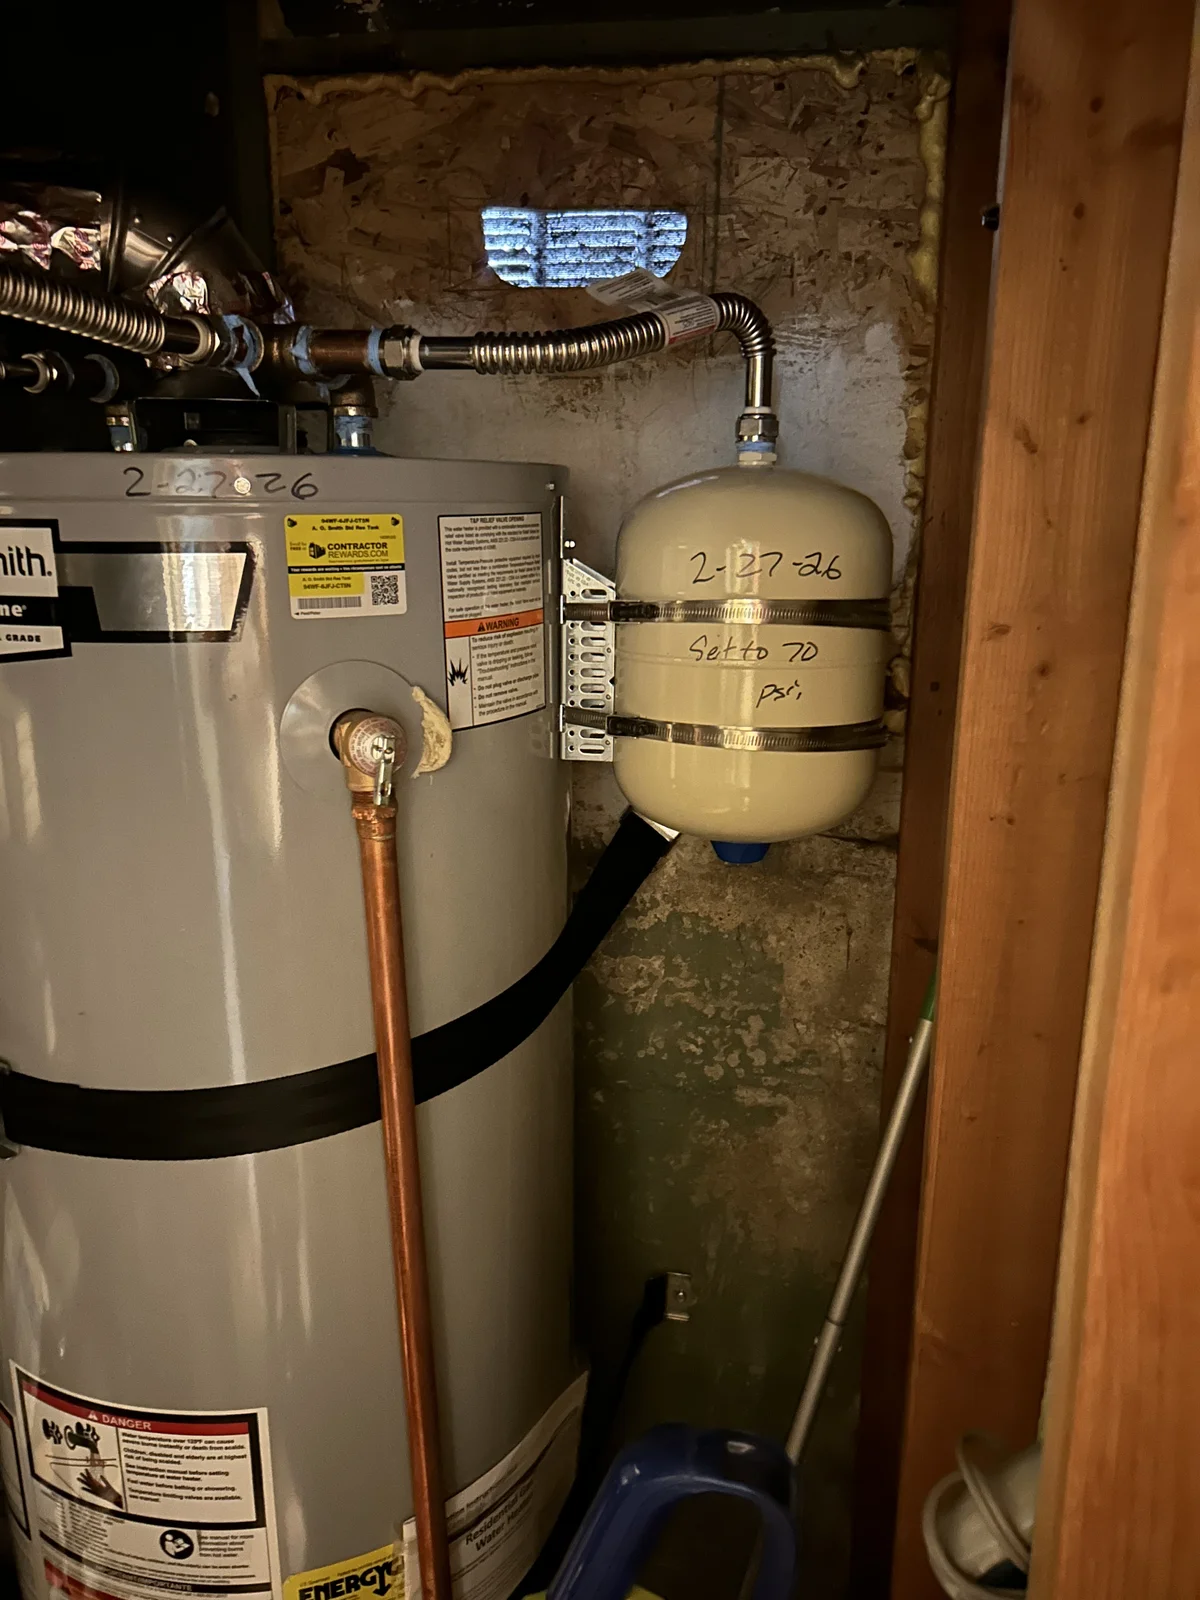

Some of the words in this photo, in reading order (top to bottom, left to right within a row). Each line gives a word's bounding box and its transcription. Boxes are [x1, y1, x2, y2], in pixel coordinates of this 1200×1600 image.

[327, 542, 388, 550] CONTRACTOR
[328, 550, 388, 558] REWARDS.COM
[690, 552, 842, 584] 2-27-26
[485, 618, 519, 631] WARNING
[6, 633, 41, 643] GRADE
[740, 640, 769, 661] to
[782, 641, 819, 662] 70
[102, 1413, 152, 1431] DANGER
[126, 1469, 158, 1478] temperature
[128, 1487, 161, 1496] Temperature
[465, 1493, 518, 1545] Residential
[475, 1522, 506, 1552] Water
